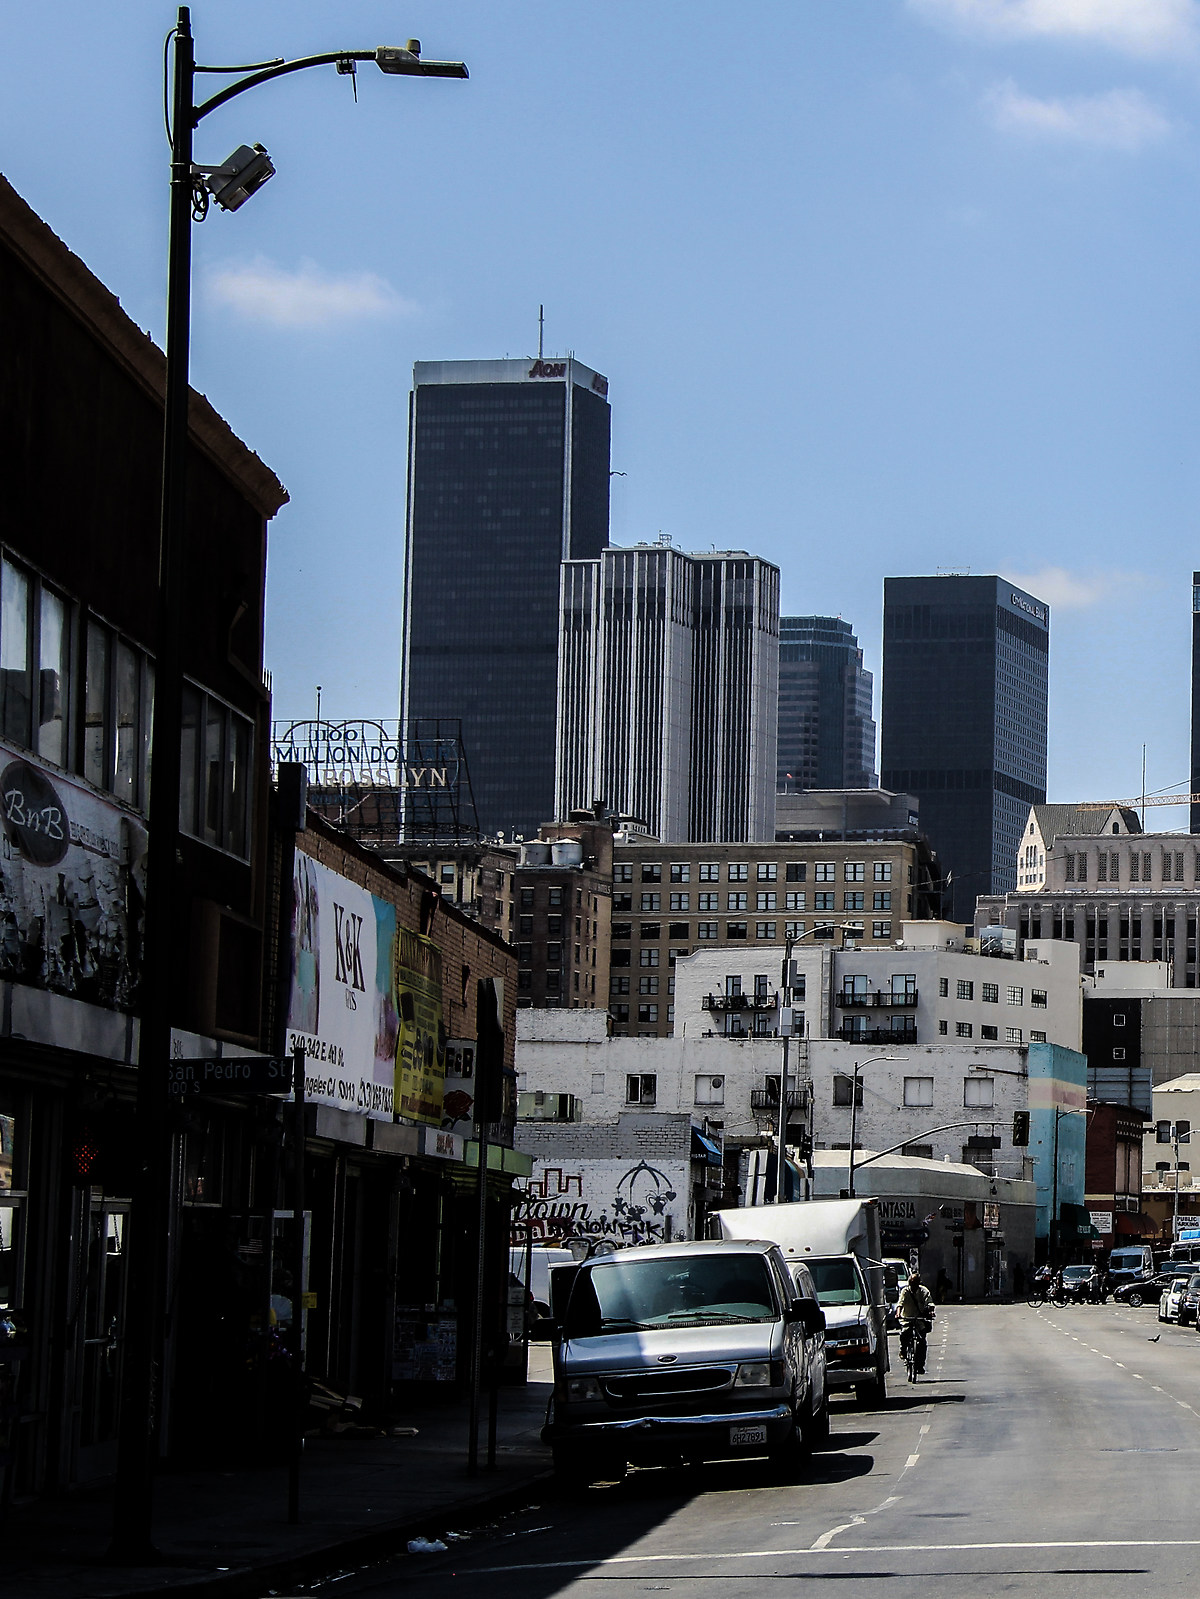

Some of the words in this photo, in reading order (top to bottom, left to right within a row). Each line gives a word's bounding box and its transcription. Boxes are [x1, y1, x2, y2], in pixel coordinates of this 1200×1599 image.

[322, 767, 448, 788] ROSSLYN
[334, 901, 366, 993] K&K
[204, 1061, 252, 1081] Pedro
[268, 1061, 287, 1080] St
[878, 1201, 916, 1219] ANTASIA
